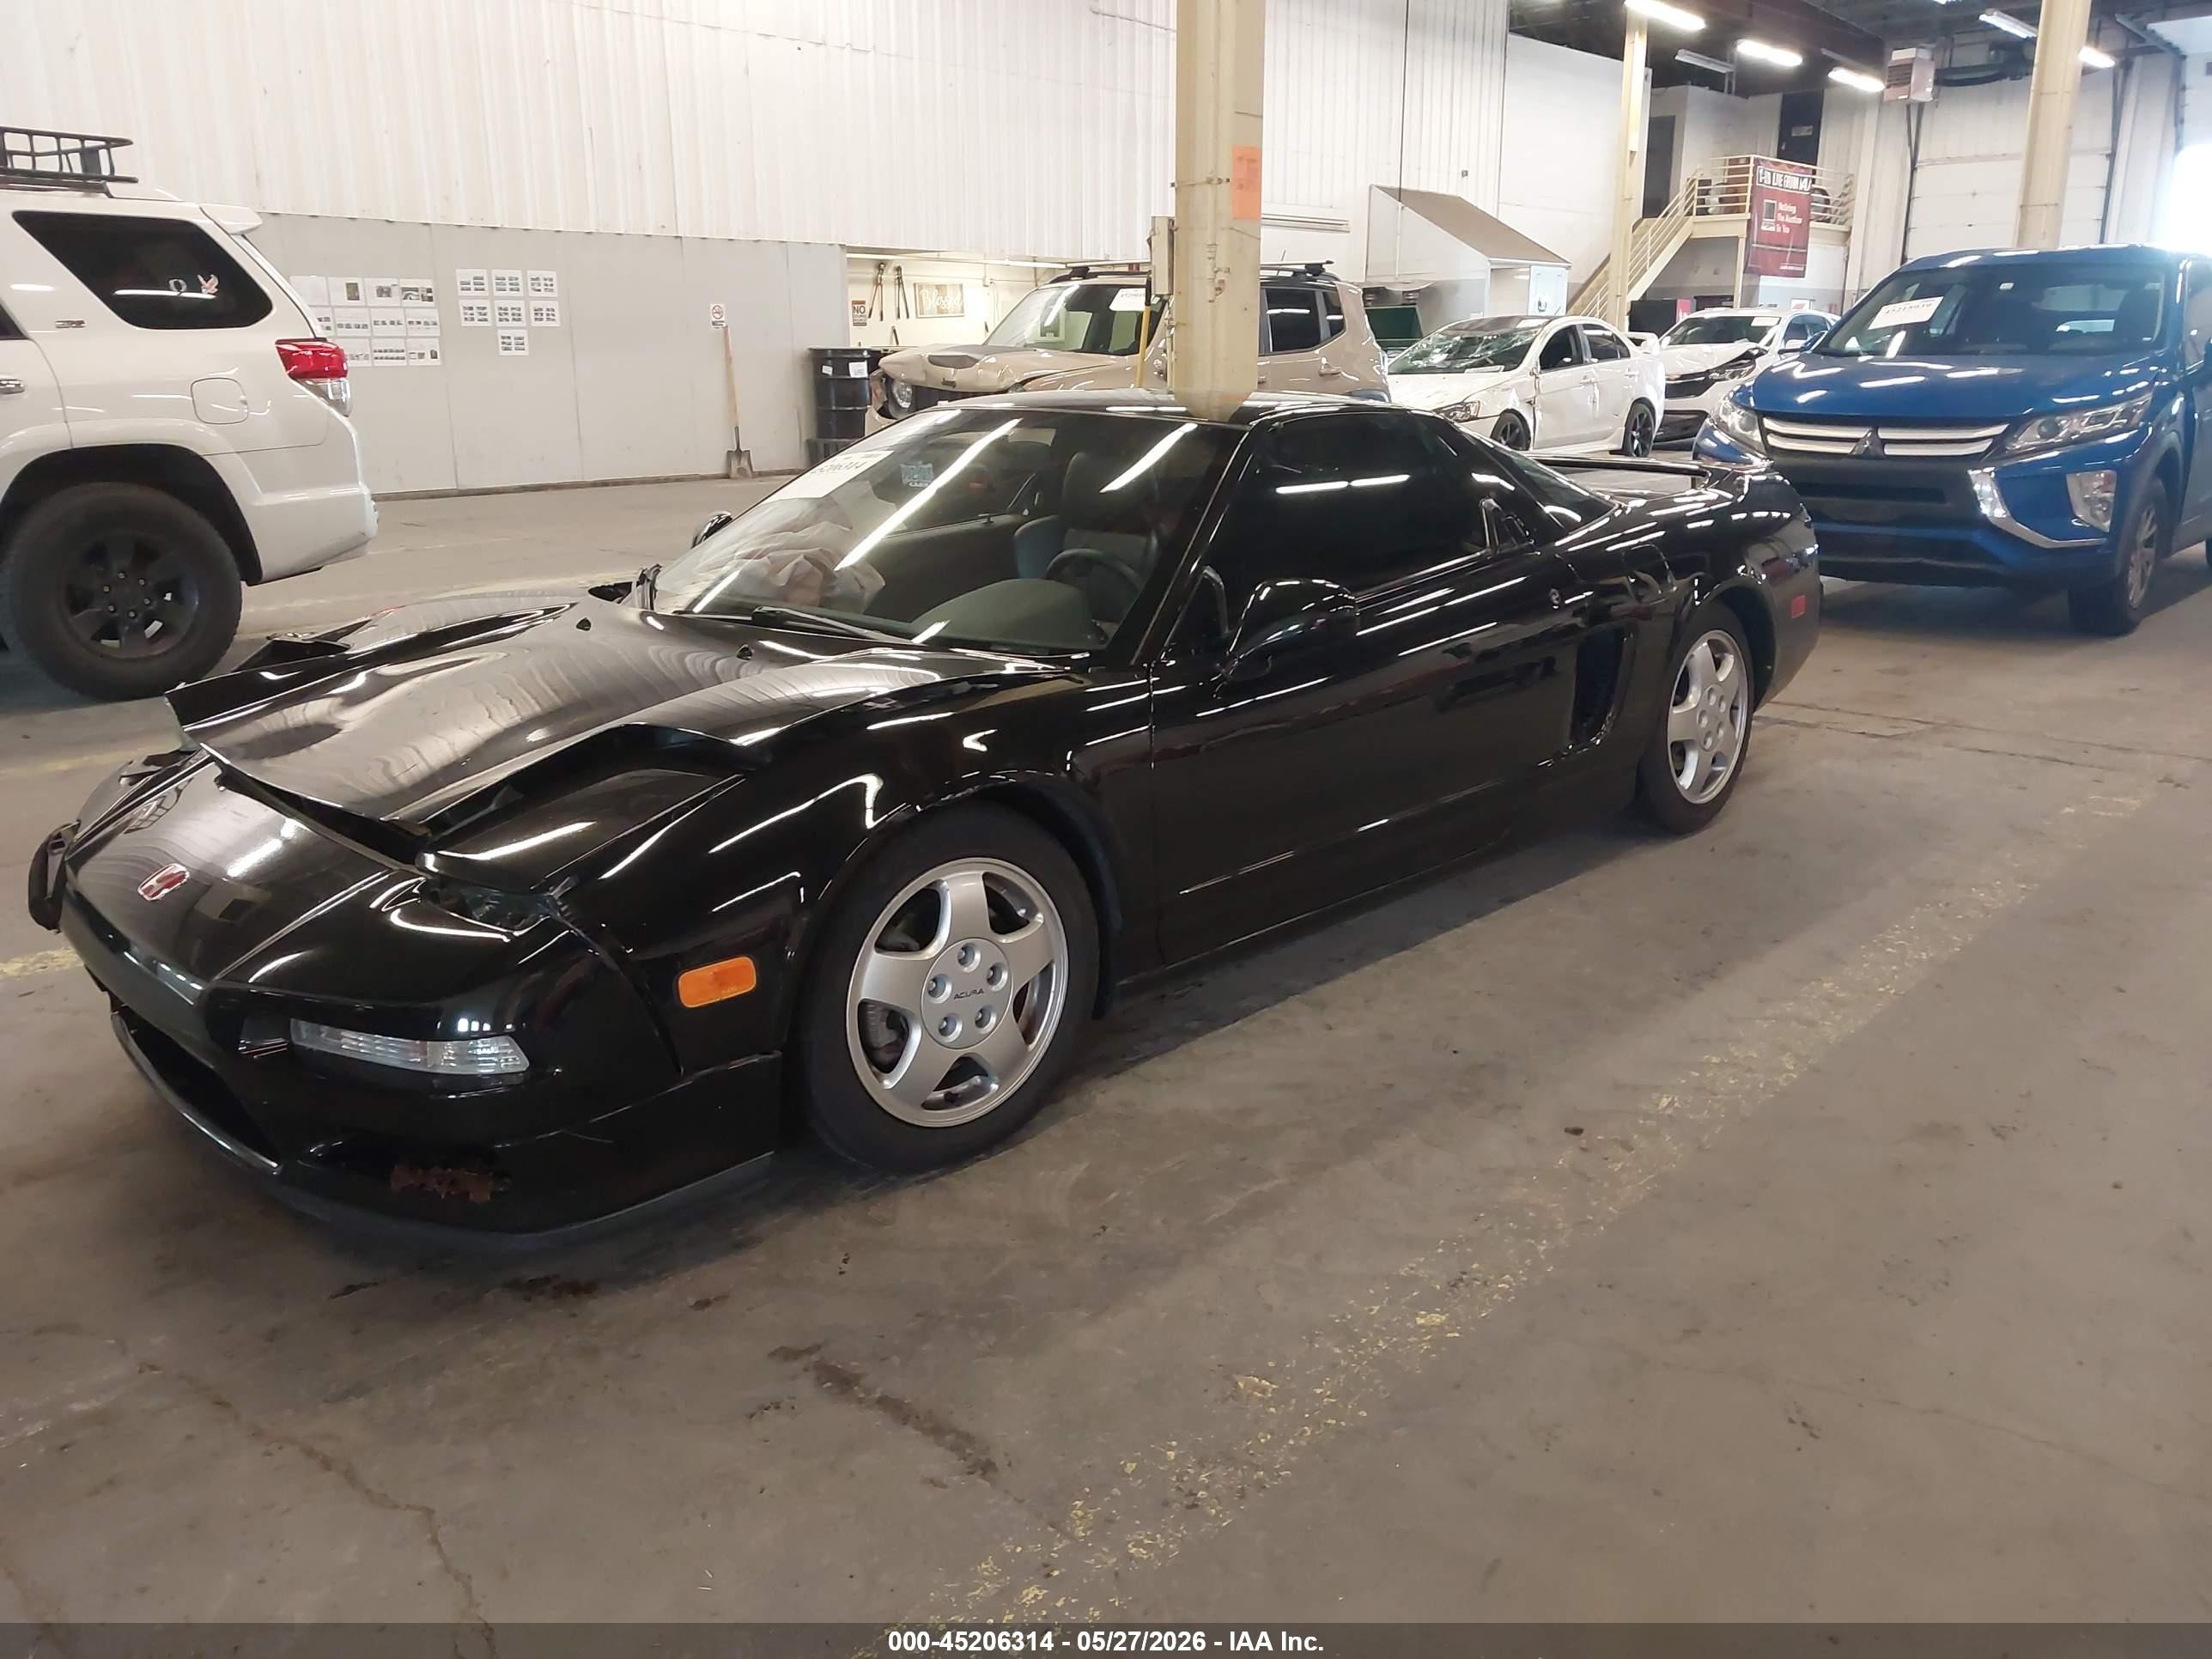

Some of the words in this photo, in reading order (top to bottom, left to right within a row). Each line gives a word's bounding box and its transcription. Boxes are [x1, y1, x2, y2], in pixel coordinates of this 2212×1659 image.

[920, 288, 963, 311] Blessed
[852, 306, 866, 314] NO
[954, 988, 985, 1000] ACURA
